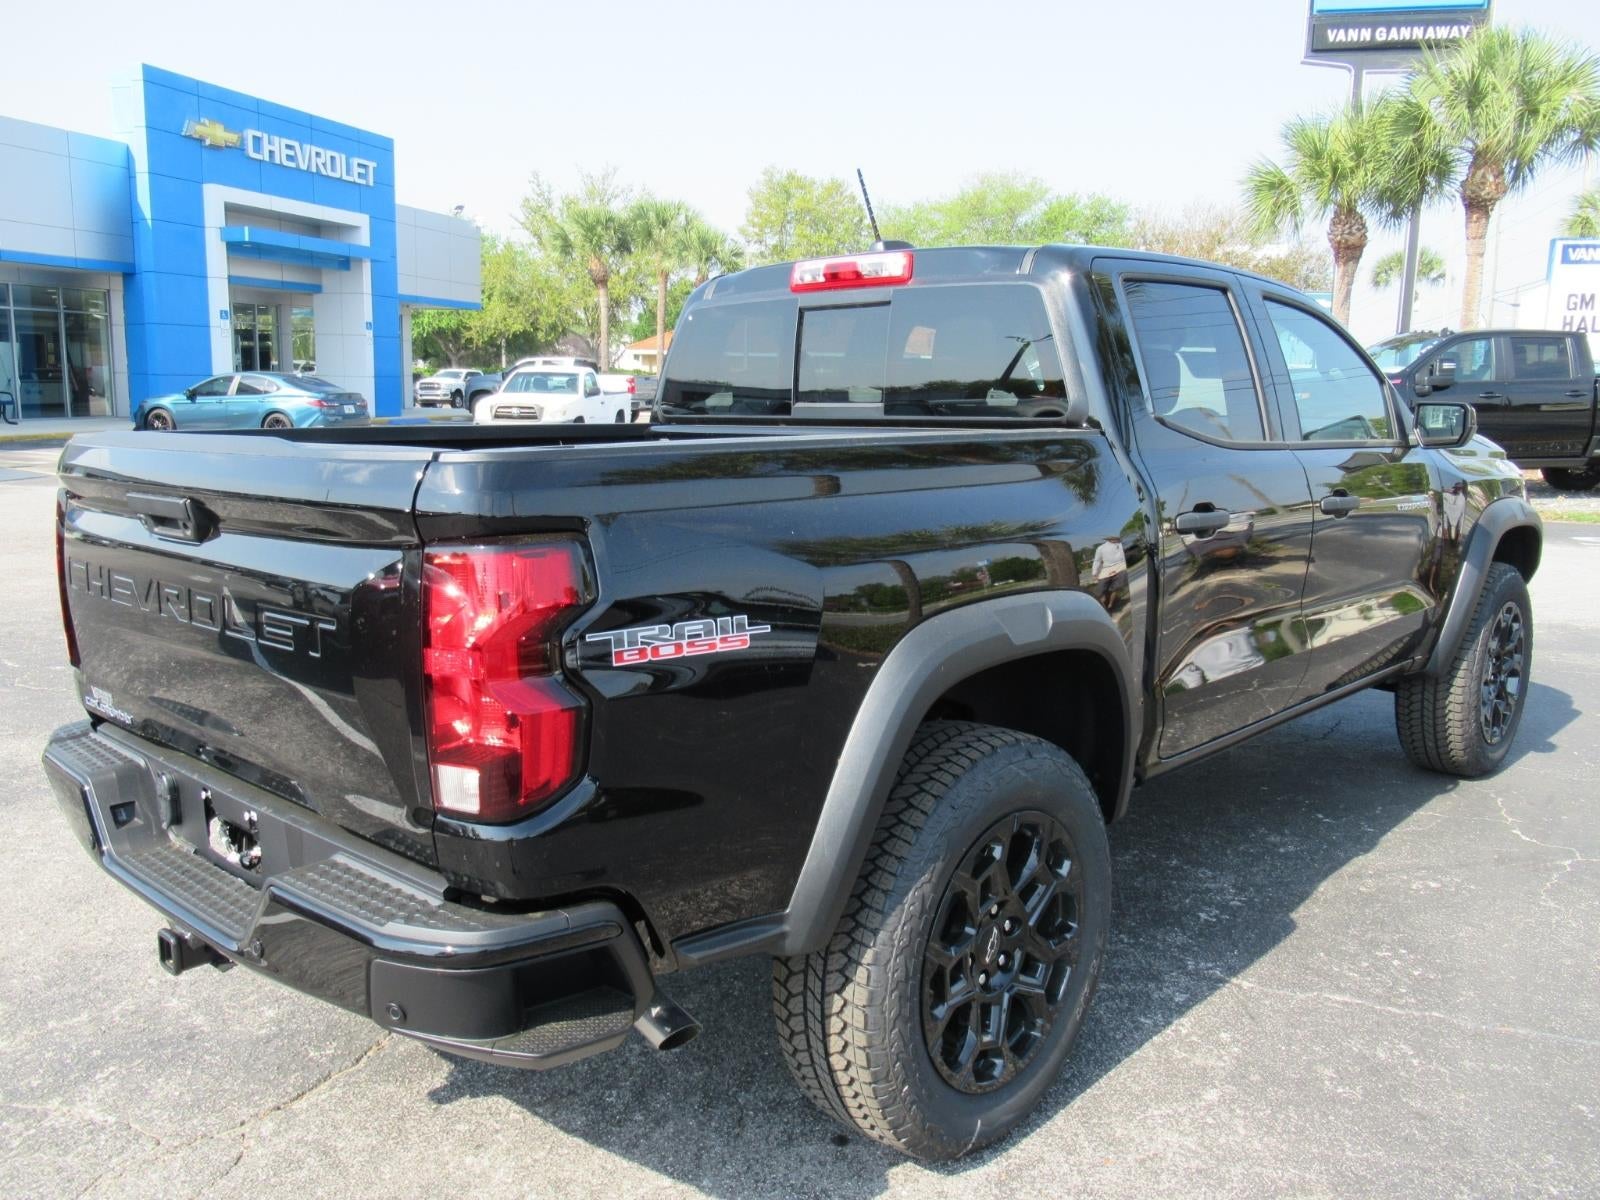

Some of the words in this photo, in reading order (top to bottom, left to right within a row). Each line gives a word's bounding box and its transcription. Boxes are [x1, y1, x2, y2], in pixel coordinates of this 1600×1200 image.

[1327, 28, 1371, 42] VANN
[1375, 25, 1471, 41] GANNAWAY
[244, 129, 377, 186] CHEVROLET
[1567, 293, 1595, 311] GM
[68, 556, 337, 658] CHEVROLET
[586, 615, 771, 650] TRAIL
[613, 633, 750, 666] BOSS
